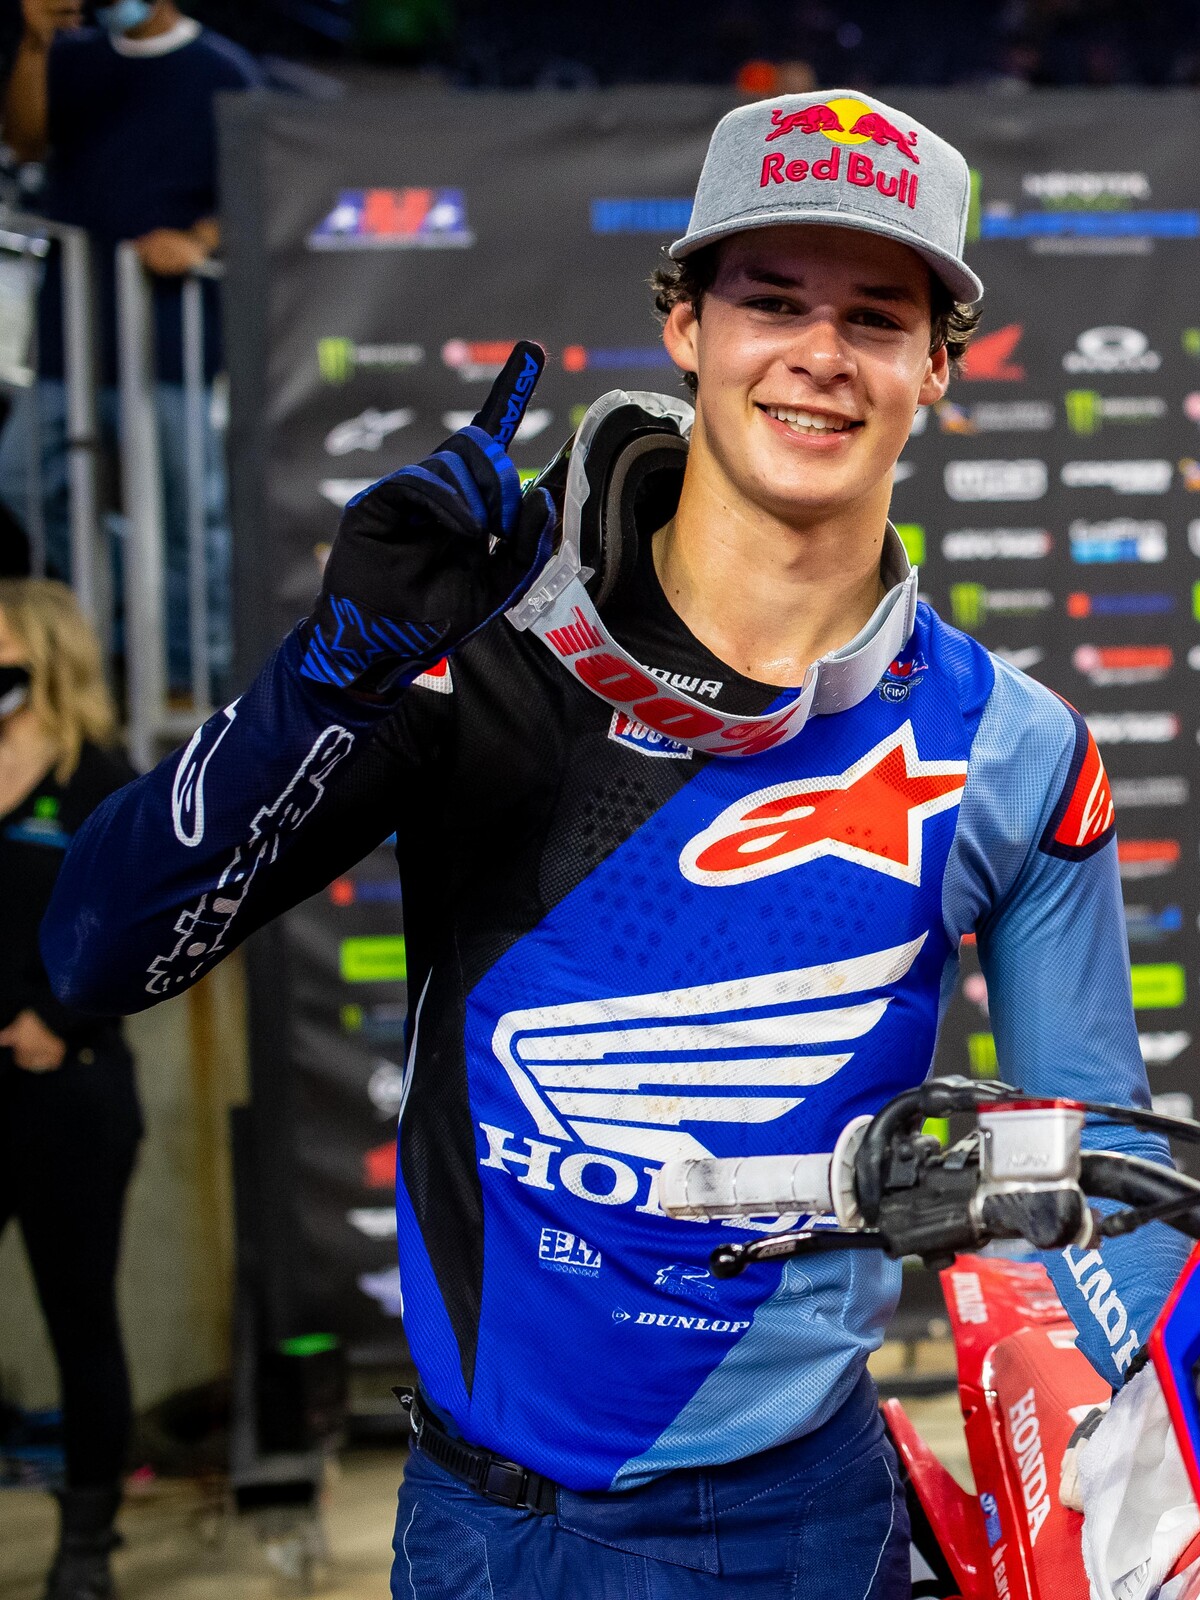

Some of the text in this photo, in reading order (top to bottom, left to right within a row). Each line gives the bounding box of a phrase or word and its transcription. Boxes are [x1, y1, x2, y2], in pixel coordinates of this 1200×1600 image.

[760, 146, 919, 209] Red Bull
[633, 1311, 750, 1333] DUNLOP
[1009, 1387, 1052, 1549] HONDA
